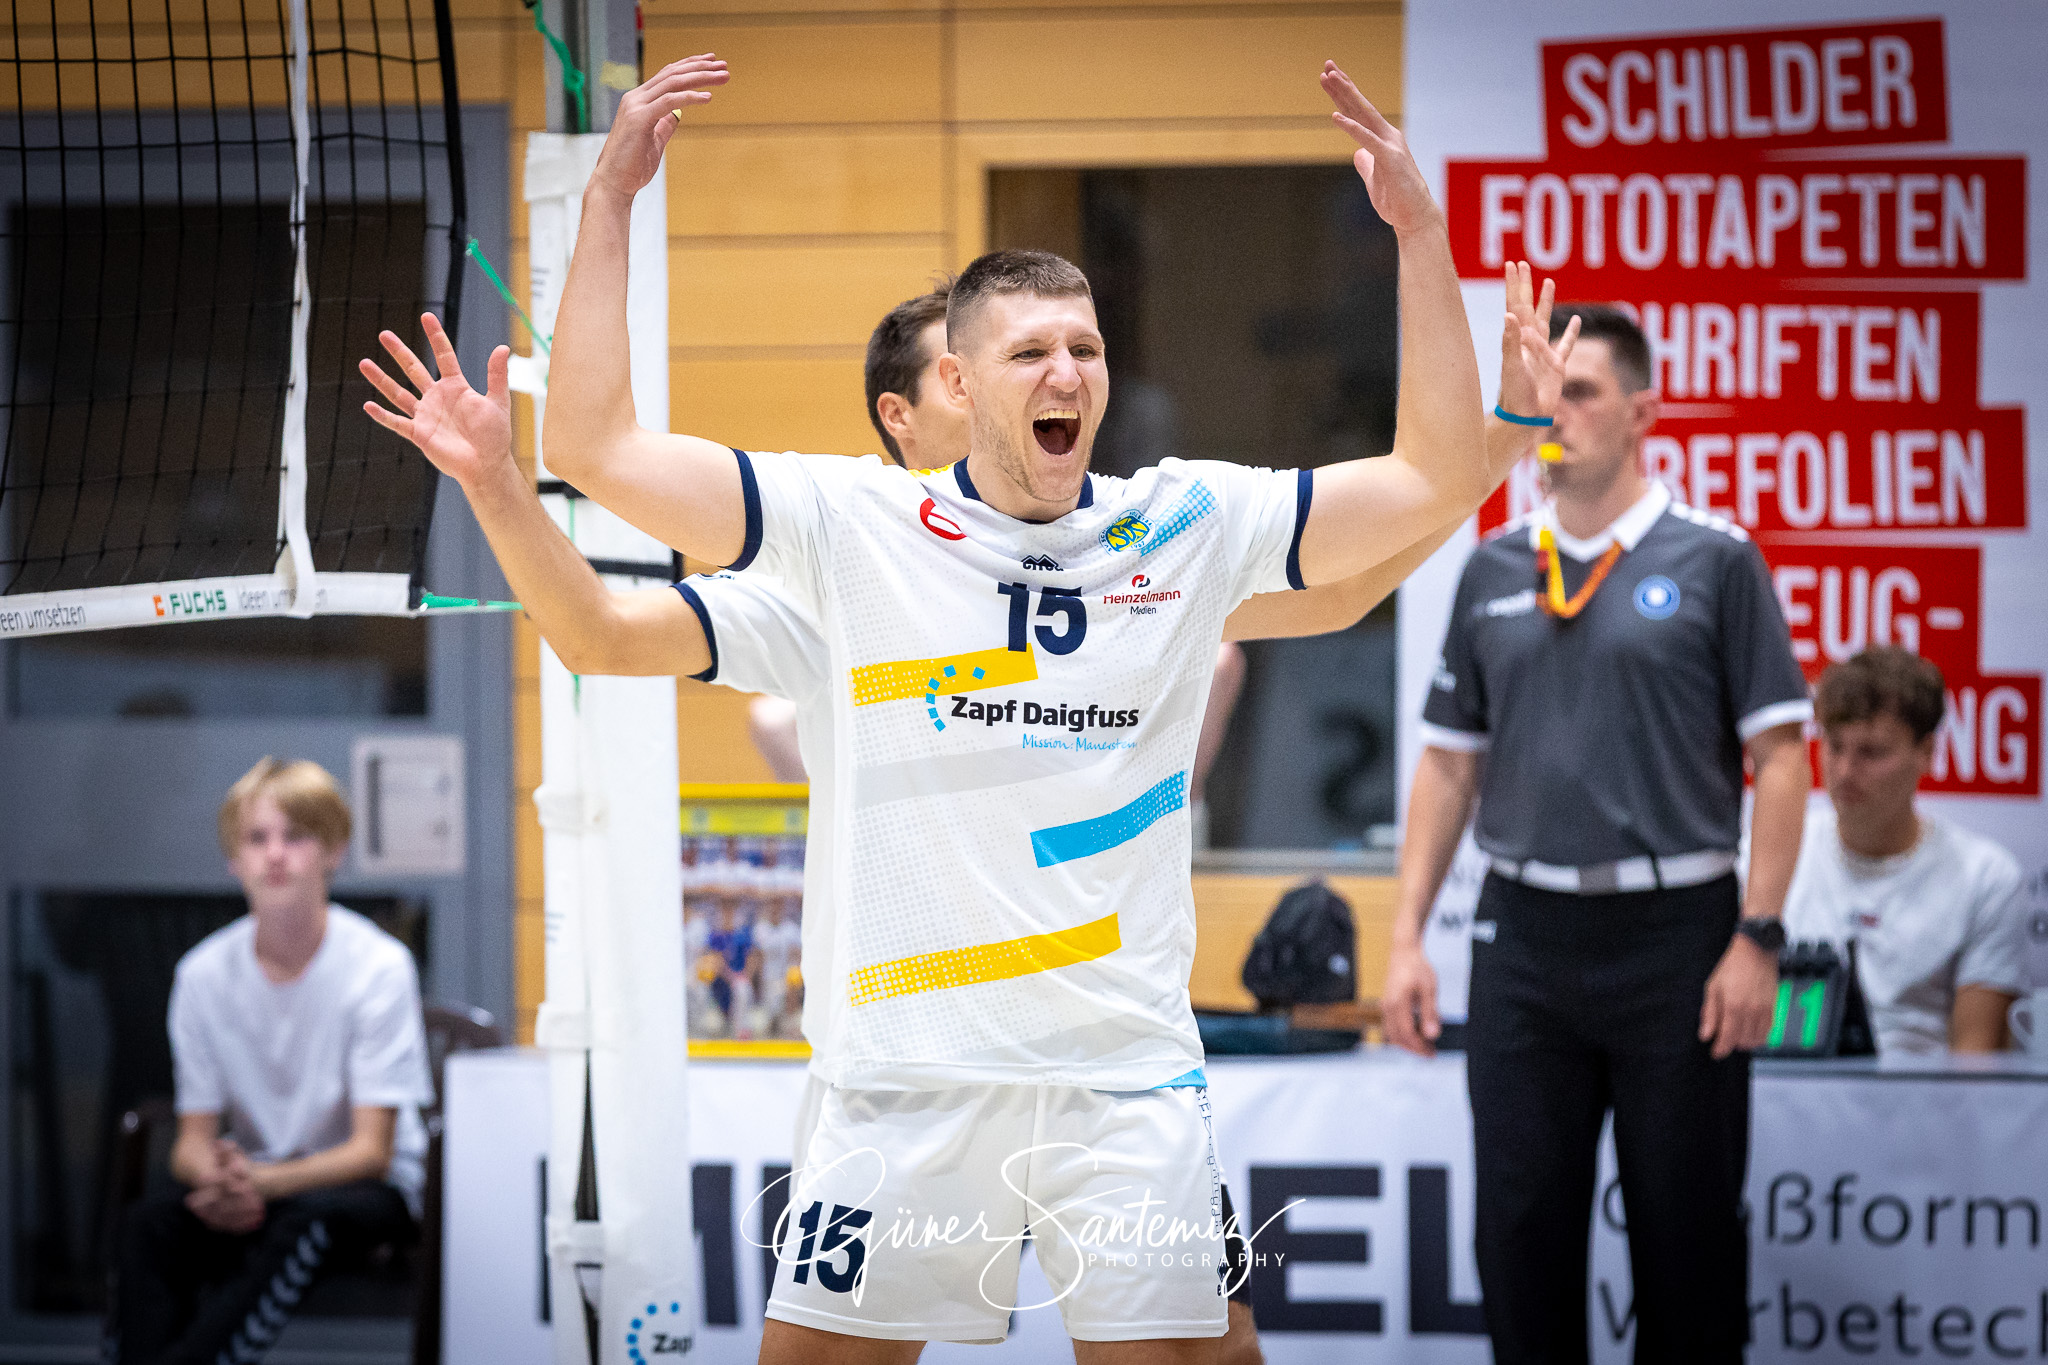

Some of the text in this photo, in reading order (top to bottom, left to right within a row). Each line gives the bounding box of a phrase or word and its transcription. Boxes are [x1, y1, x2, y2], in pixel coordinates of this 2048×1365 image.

[1560, 35, 1918, 148] SCHILDER
[1478, 172, 1988, 271] FOTOTAPETEN
[1612, 300, 1942, 402] HRIFTEN
[0, 602, 86, 631] een umsetzen
[169, 589, 227, 615] FUCHS
[998, 581, 1088, 656] 15
[1103, 590, 1181, 605] Heinzelmann
[1130, 605, 1157, 615] Medien
[1773, 562, 1965, 663] EUG-
[950, 696, 1140, 733] Zapf Daigfuss
[1022, 733, 1138, 752] Mission: Mauerstein
[1740, 1171, 2042, 1247] ßform
[793, 1200, 873, 1294] 15
